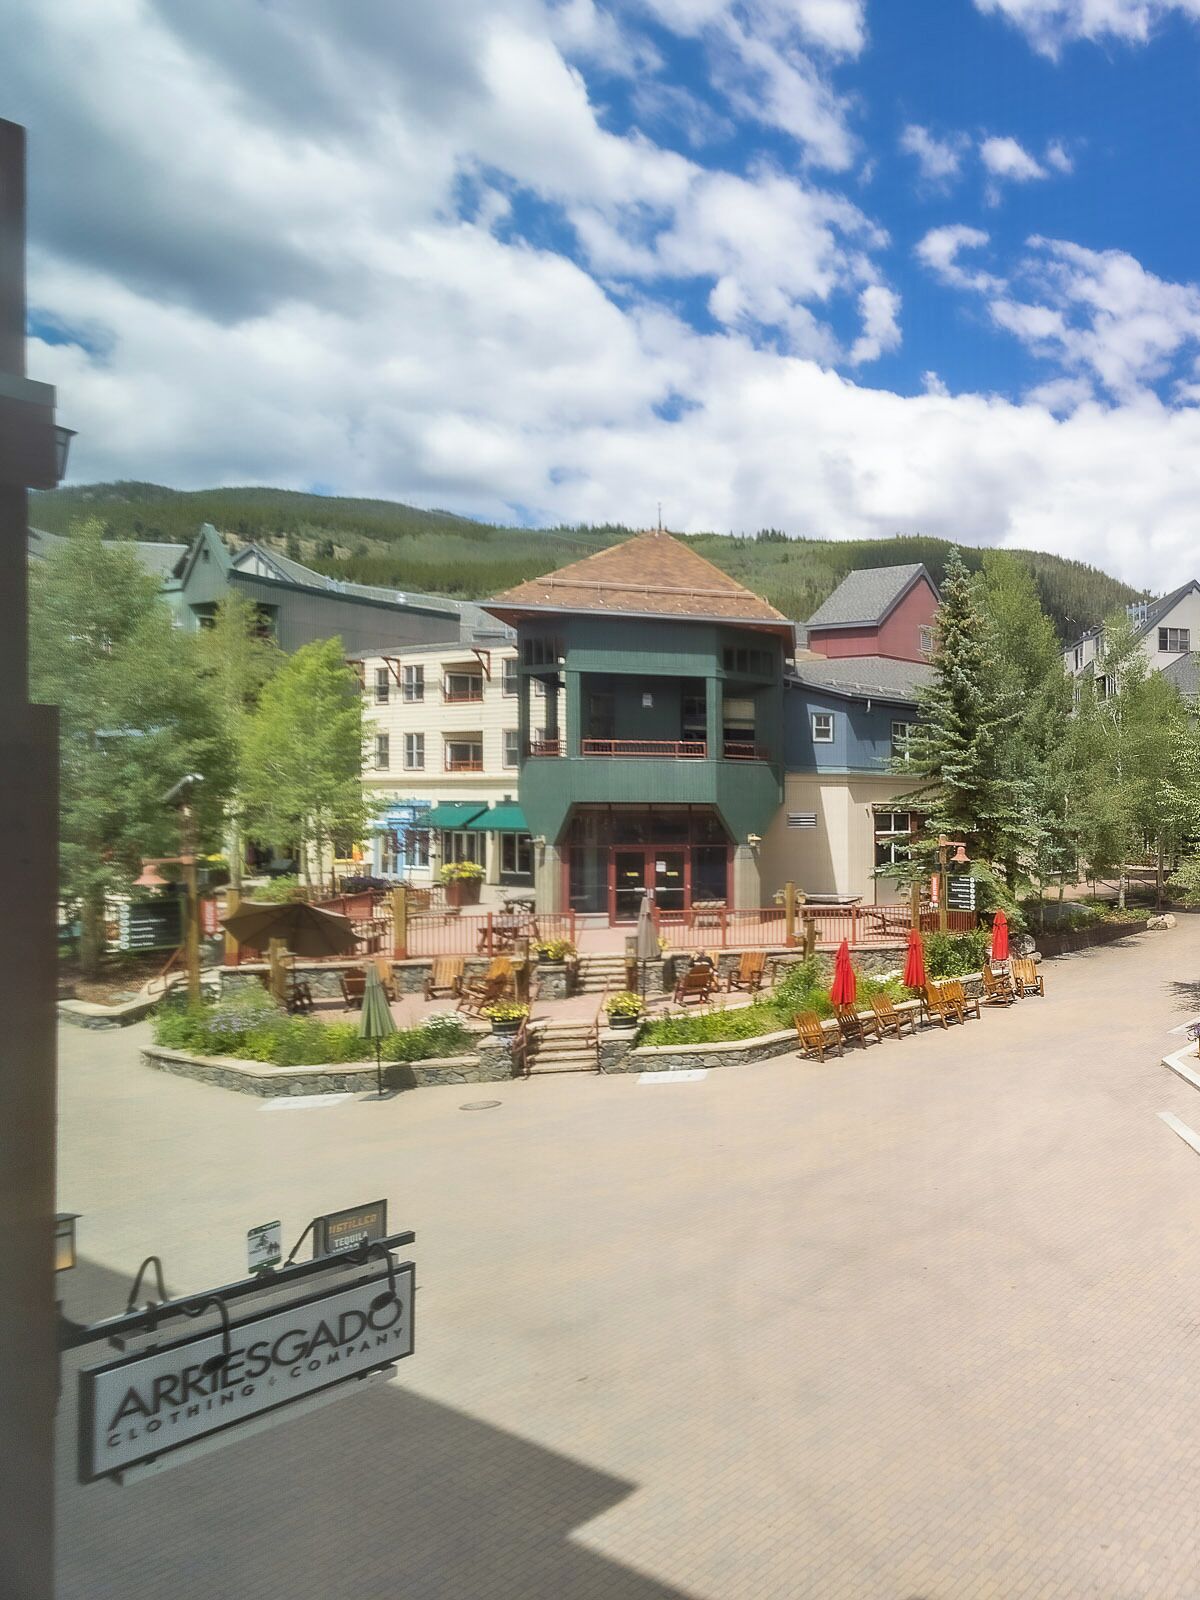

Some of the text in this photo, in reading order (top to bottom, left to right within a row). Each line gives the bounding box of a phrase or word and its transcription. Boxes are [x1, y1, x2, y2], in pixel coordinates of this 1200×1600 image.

[334, 1230, 369, 1248] TEQUILA
[107, 1384, 256, 1447] CLOTHING
[290, 1327, 403, 1378] COMPANY
[108, 1292, 404, 1432] ARRIESGADO
